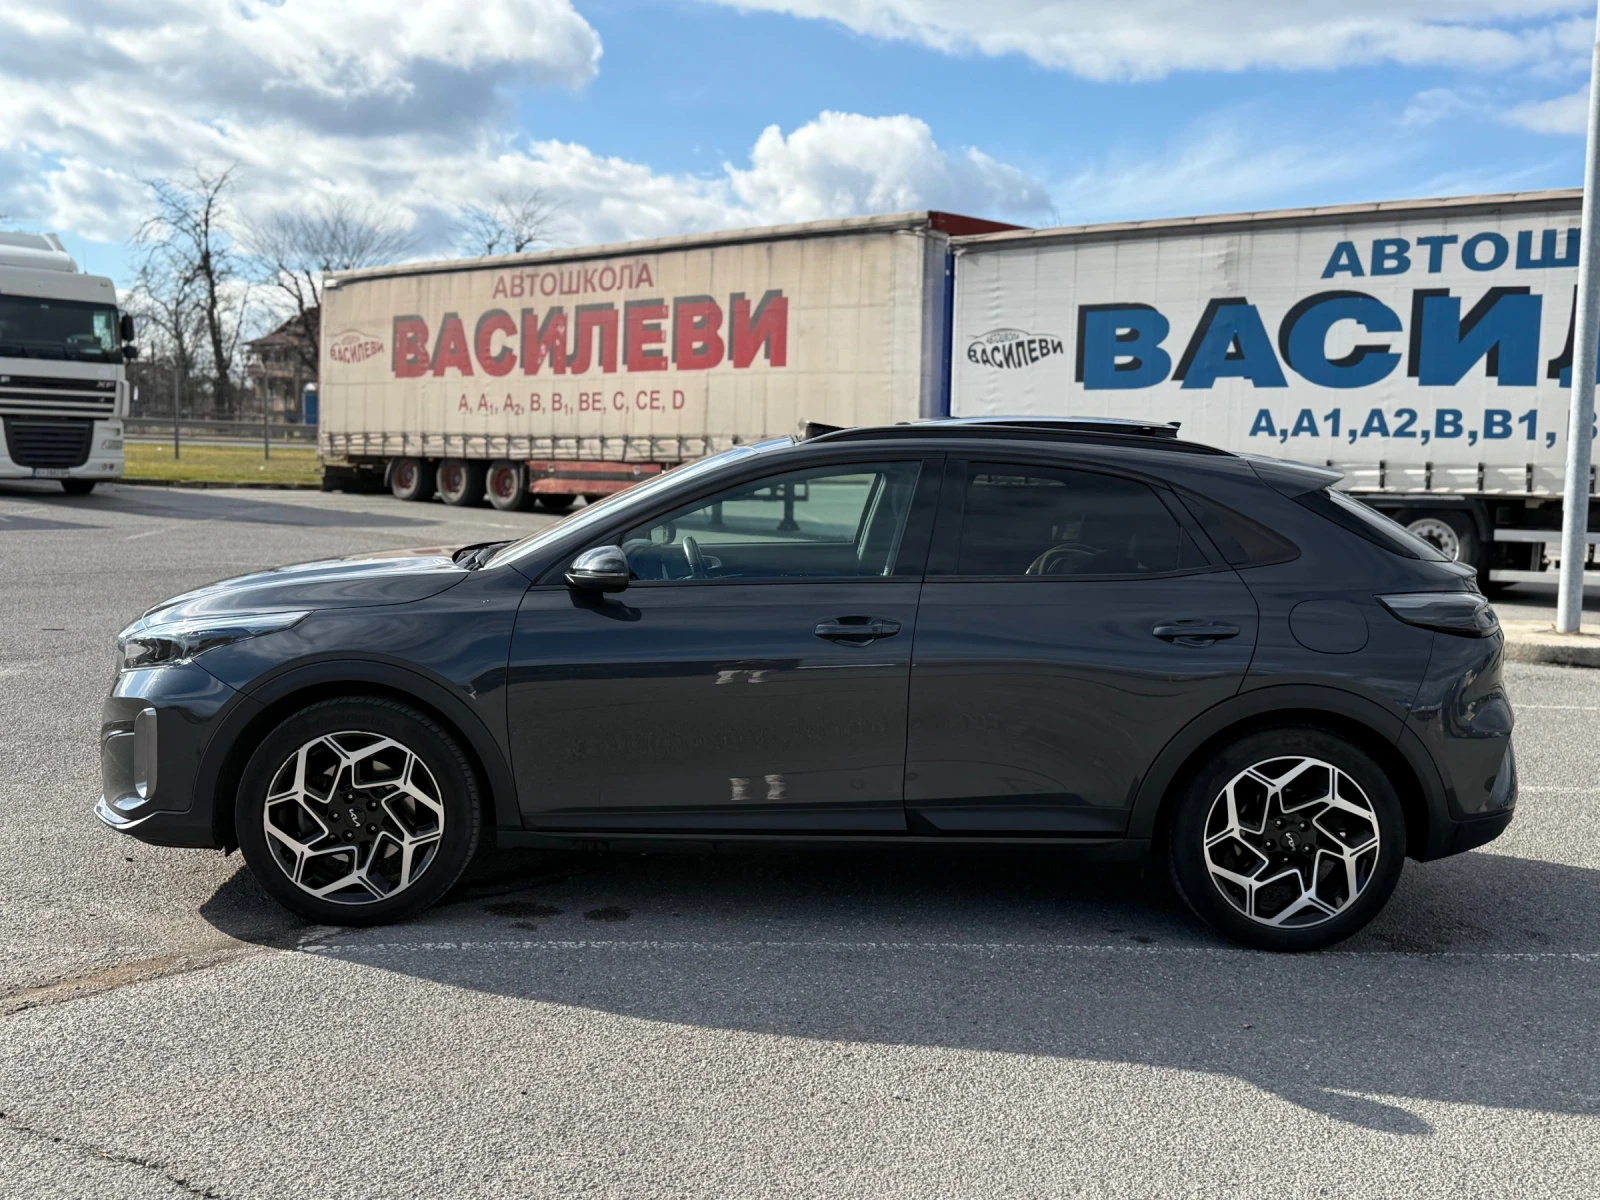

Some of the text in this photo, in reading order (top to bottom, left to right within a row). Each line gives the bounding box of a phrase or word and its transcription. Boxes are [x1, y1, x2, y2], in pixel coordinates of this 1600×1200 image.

[492, 263, 654, 299] АВТОШКОЛА
[391, 289, 789, 379] ВАСИЛЕВИ
[967, 338, 1064, 369] ВАСИЛЕВИ
[672, 390, 685, 410] D
